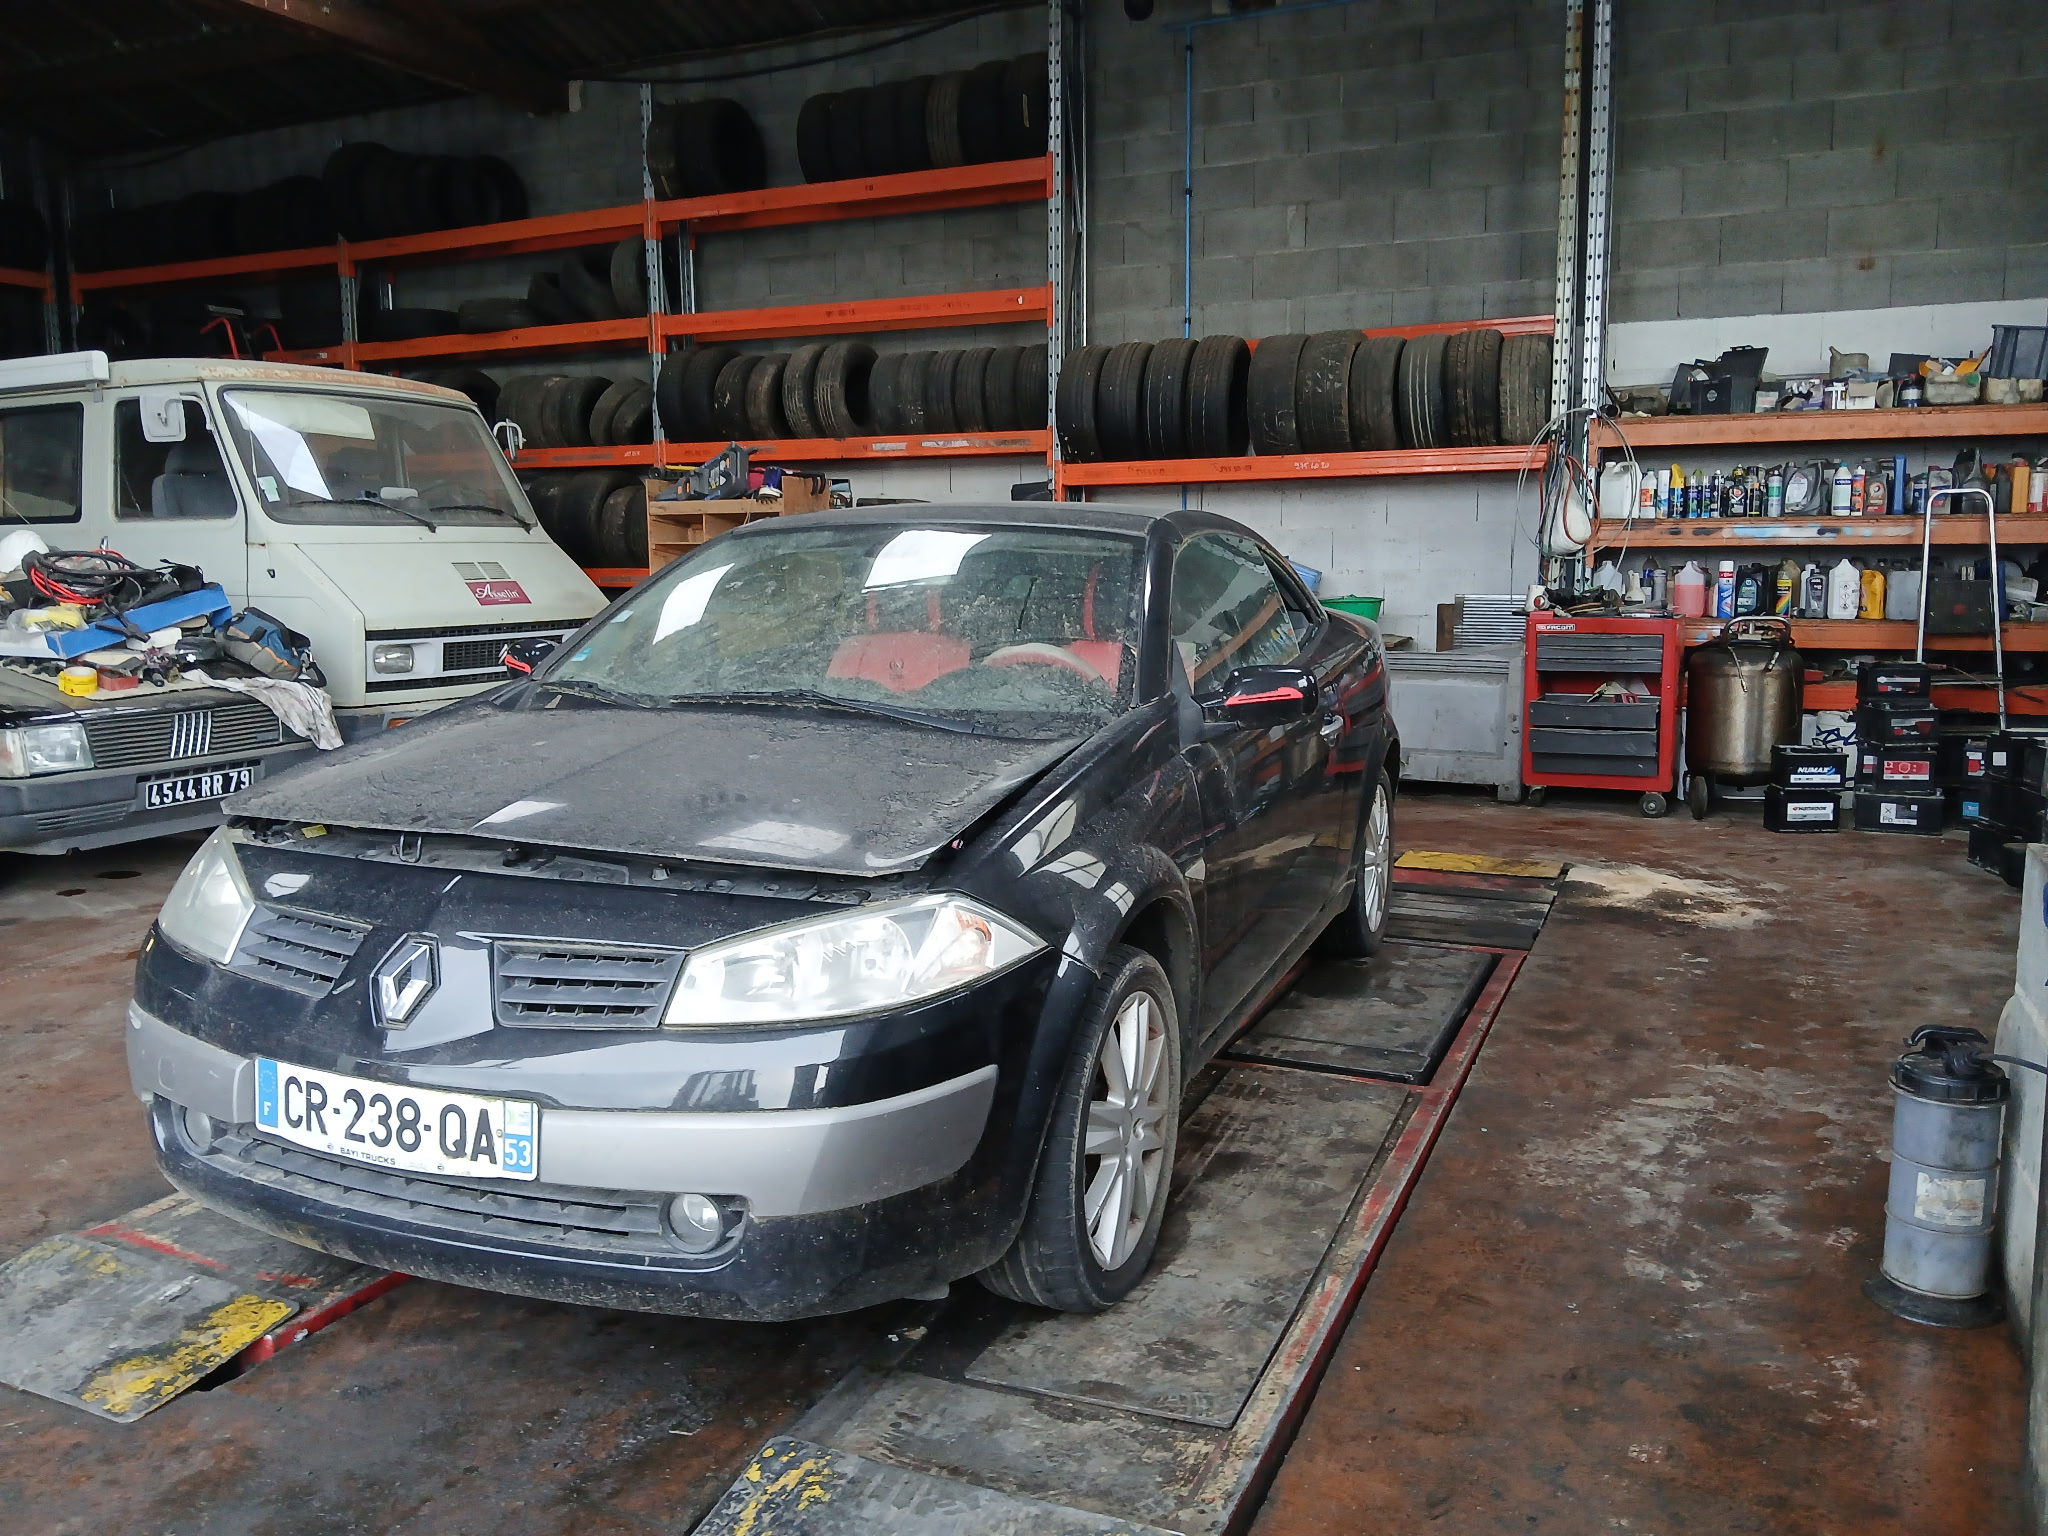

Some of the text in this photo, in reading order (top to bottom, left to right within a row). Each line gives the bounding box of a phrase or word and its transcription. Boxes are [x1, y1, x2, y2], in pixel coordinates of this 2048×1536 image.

[1797, 766, 1830, 774] NUMAX
[151, 770, 250, 806] 4544 RR 79
[263, 1102, 272, 1116] F
[284, 1075, 498, 1165] CR-238-QA
[340, 1147, 359, 1158] BAYI
[361, 1152, 396, 1166] TRUCKS
[504, 1138, 531, 1167] 53
